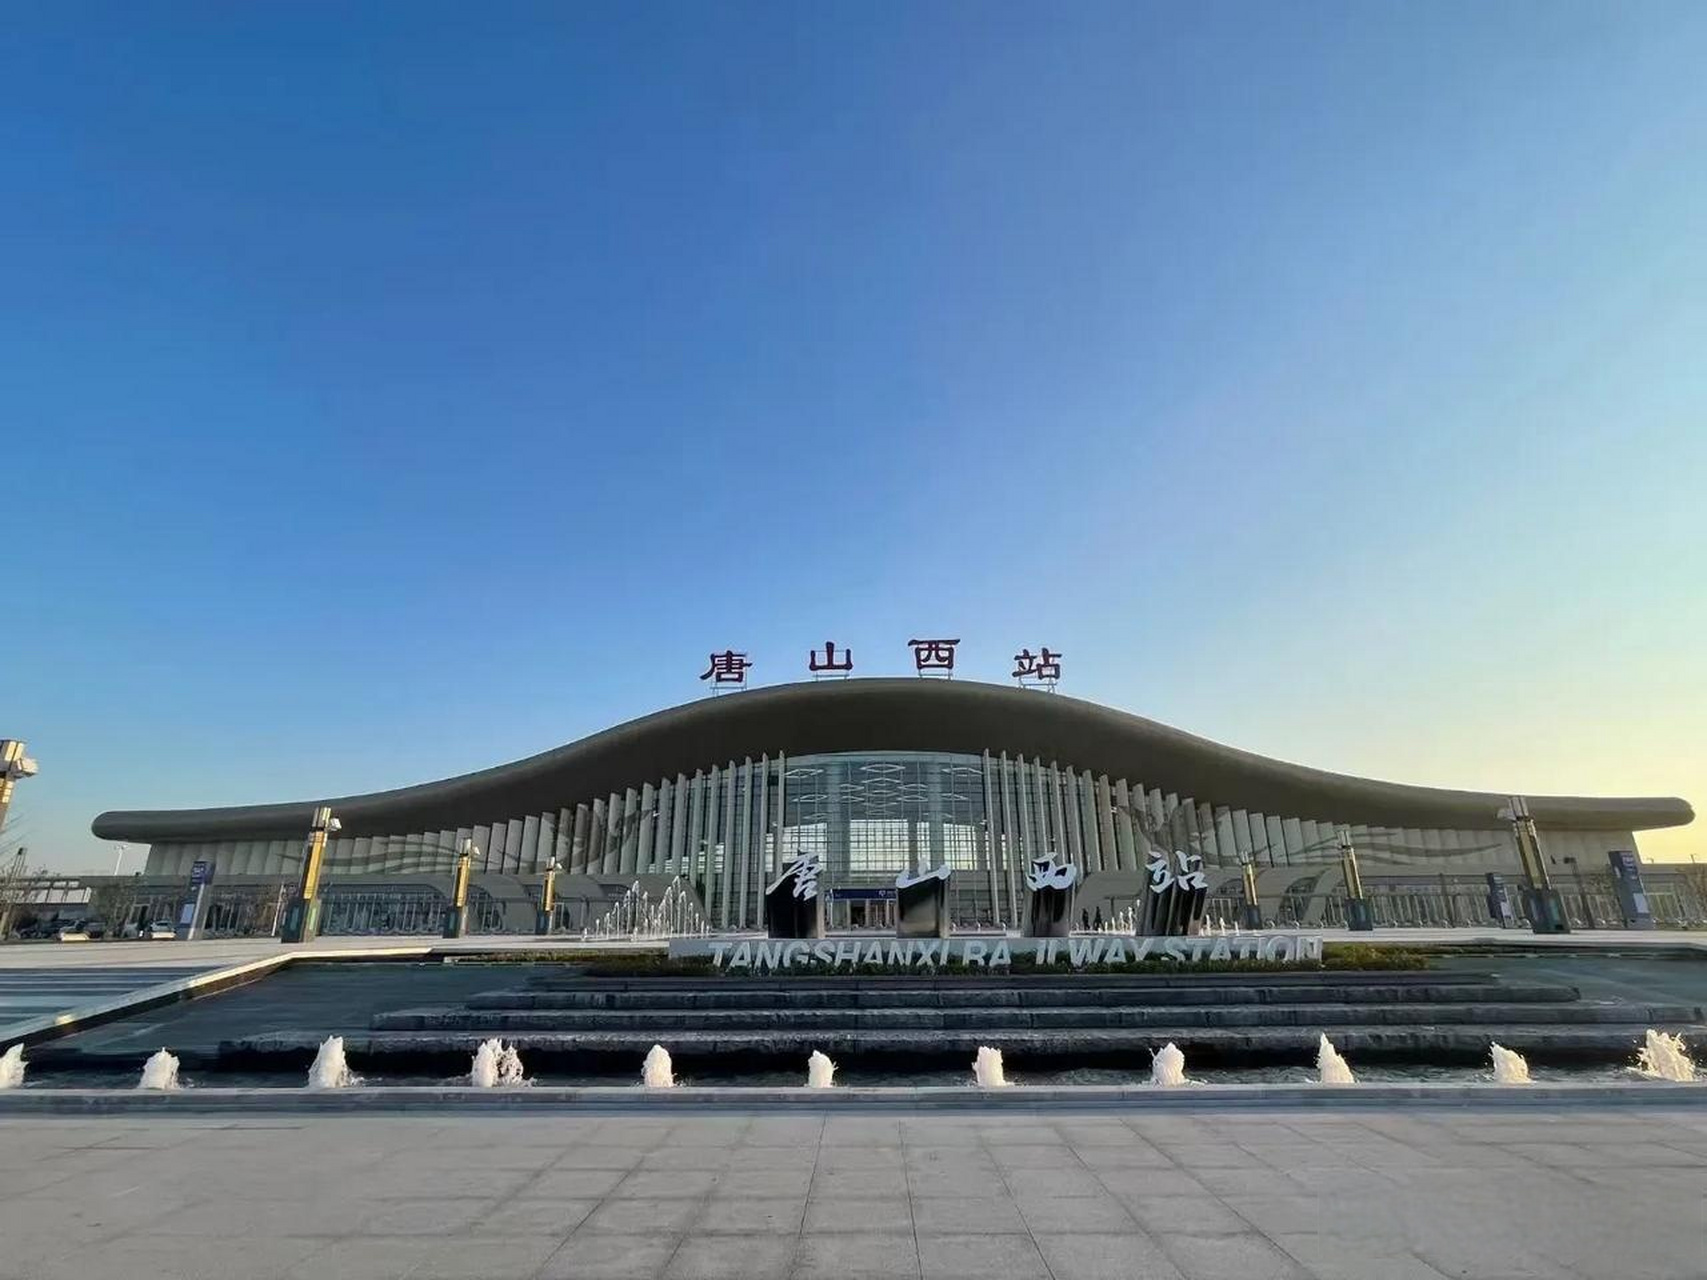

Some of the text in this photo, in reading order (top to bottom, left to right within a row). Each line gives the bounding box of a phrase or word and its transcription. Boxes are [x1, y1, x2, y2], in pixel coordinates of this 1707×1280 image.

[700, 638, 1062, 682] 唐山西站
[766, 850, 1208, 901] 唐山西站
[708, 940, 950, 968] TANGSHANXI
[1160, 936, 1324, 962] STATION
